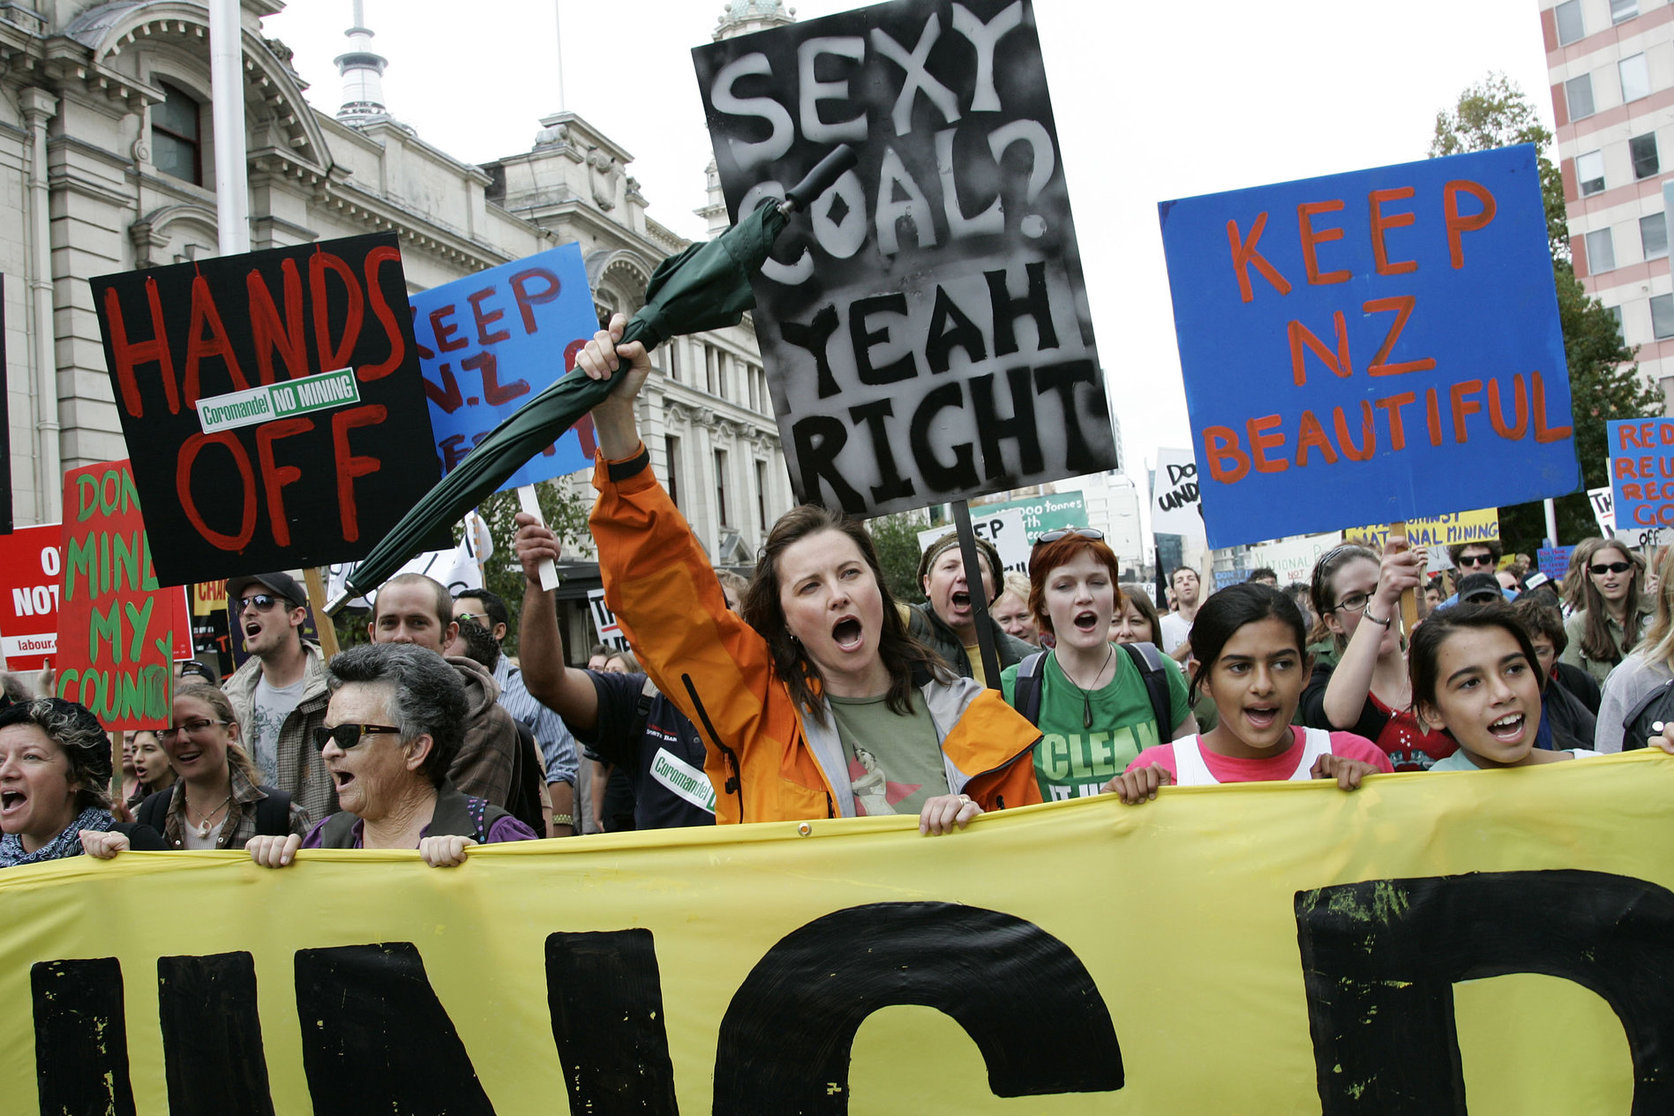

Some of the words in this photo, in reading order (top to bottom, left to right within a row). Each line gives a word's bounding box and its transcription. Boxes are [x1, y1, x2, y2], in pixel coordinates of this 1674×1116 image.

[710, 0, 1023, 170] SEXY
[1226, 179, 1497, 303] KEEP
[104, 243, 405, 418] HANDS
[780, 261, 1059, 400] YEAH
[1287, 295, 1436, 387] NZ
[203, 394, 270, 426] Coromandel
[272, 386, 296, 413] NO
[296, 375, 354, 408] MINING
[793, 359, 1097, 513] RIGHT
[1202, 371, 1573, 485] BEAUTIFUL
[176, 404, 388, 555] OFF
[1044, 500, 1083, 513] tonnes
[1446, 521, 1498, 543] MINING
[90, 596, 154, 666] MY
[655, 756, 710, 801] Coromandel
